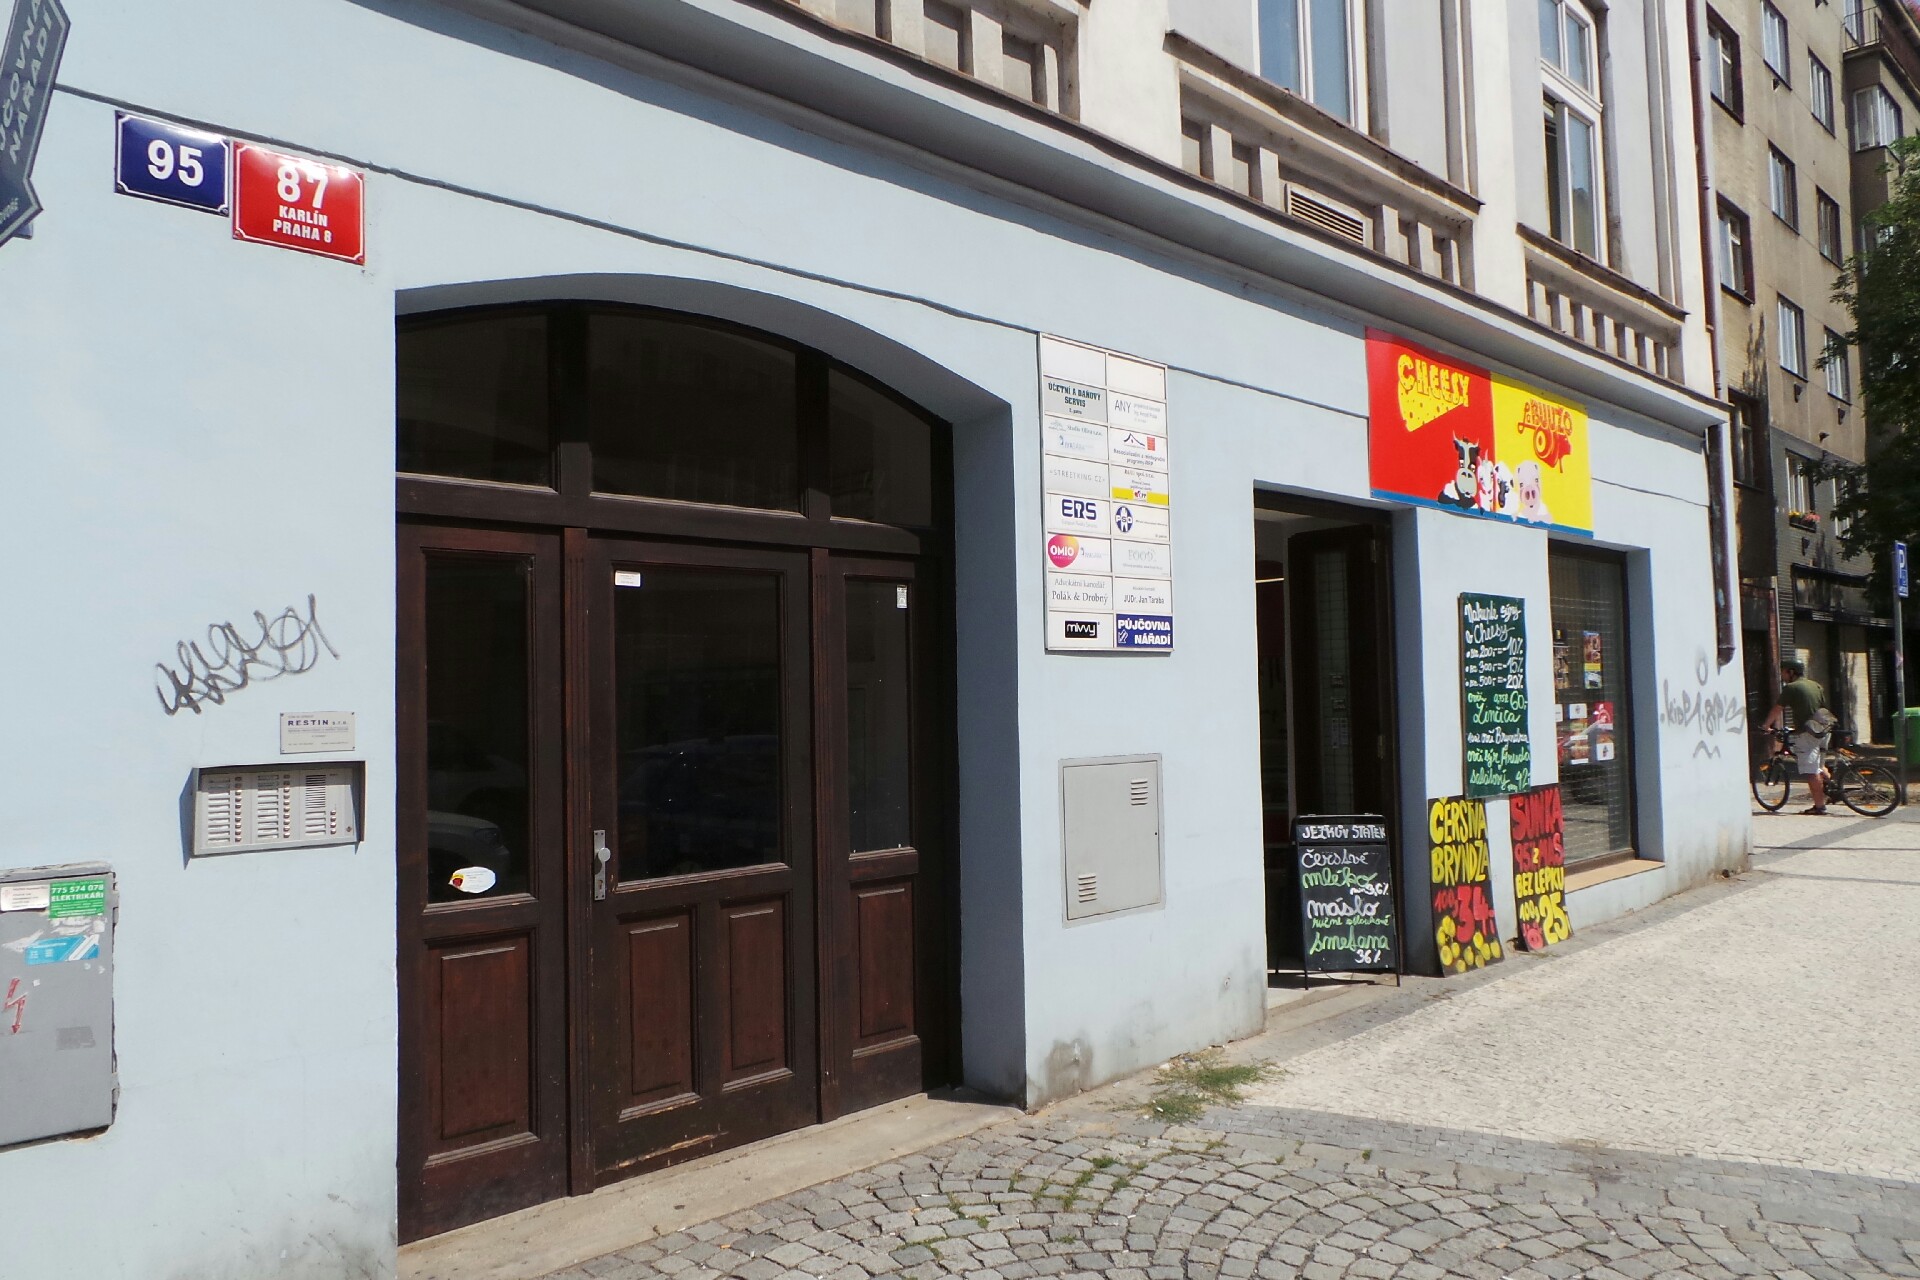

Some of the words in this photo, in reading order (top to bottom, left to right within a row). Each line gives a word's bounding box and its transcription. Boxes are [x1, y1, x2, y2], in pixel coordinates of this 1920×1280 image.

[147, 139, 204, 187] 95
[276, 165, 329, 209] 87
[278, 205, 329, 228] KARLÍN
[273, 218, 320, 242] PRAHA
[323, 230, 332, 243] 8
[1398, 354, 1470, 408] CHEESY
[1065, 396, 1086, 408] SERVIS
[1114, 399, 1132, 414] ANY
[1062, 499, 1097, 520] ERS
[1050, 545, 1075, 557] OMIO
[1052, 590, 1071, 601] Polák
[1073, 593, 1080, 601] &
[1082, 592, 1108, 605] Drobný
[1118, 617, 1171, 631] PŮJČOVNA
[1134, 632, 1171, 645] NÁŘADÍ
[1431, 841, 1490, 886] BRYNDZA
[1515, 871, 1534, 898] BEZ
[1534, 866, 1565, 895] LEPKU
[1307, 895, 1380, 919] máslo
